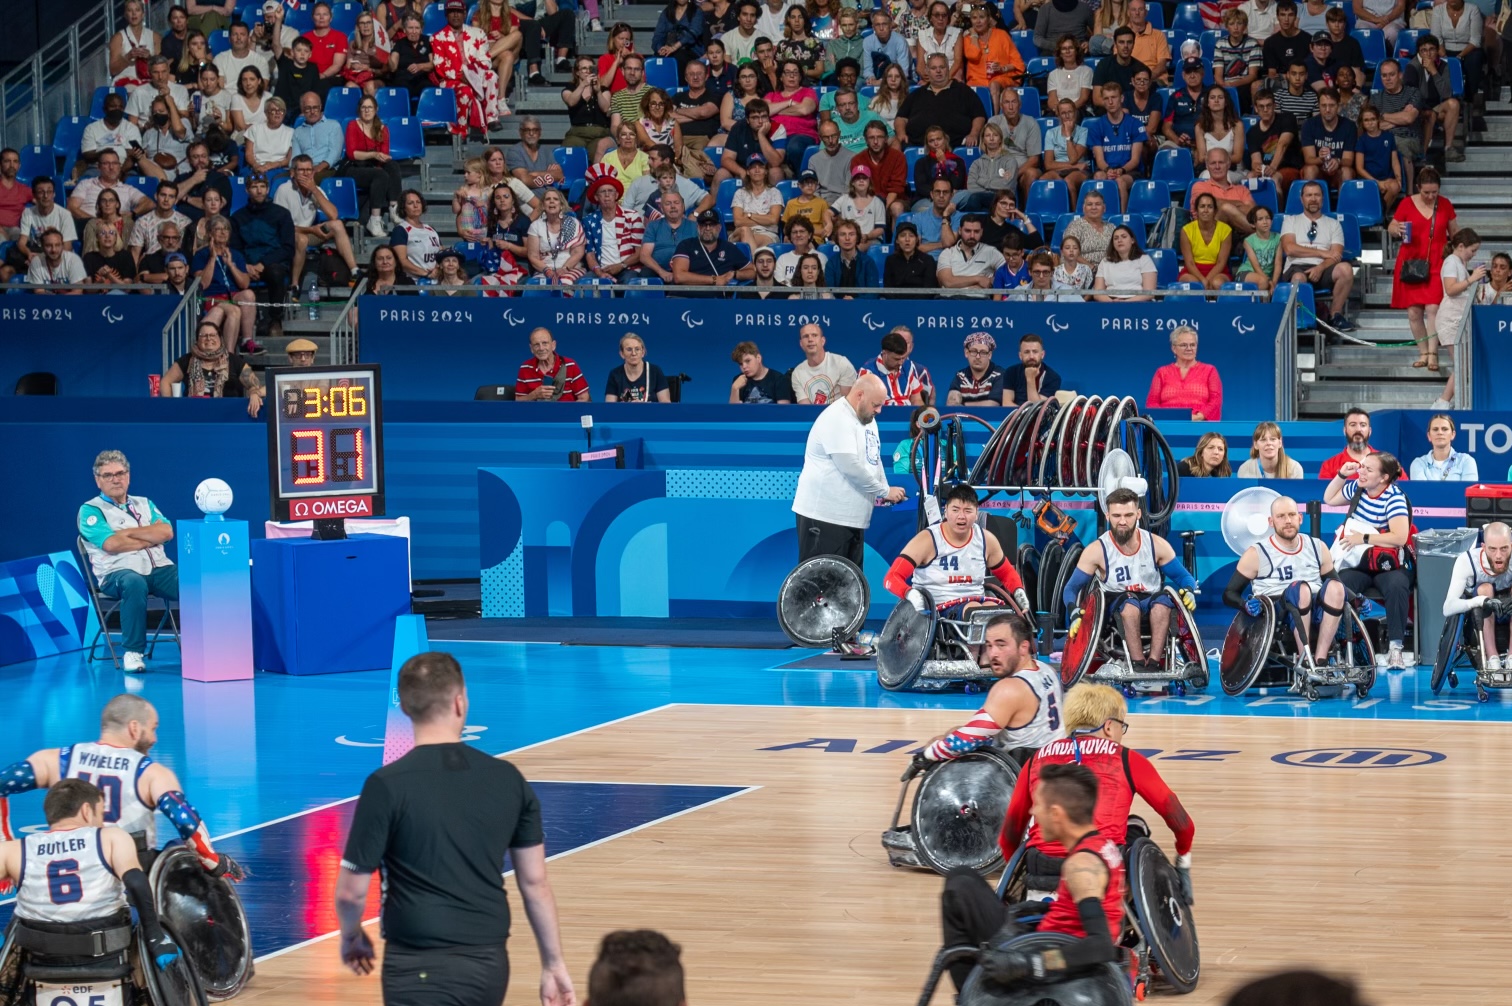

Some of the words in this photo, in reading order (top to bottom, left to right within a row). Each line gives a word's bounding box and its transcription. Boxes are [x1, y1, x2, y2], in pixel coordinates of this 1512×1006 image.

[3, 308, 26, 320] RIS
[304, 386, 367, 418] 3:06
[292, 430, 364, 485] 31
[312, 499, 369, 515] OMEGA
[939, 555, 959, 571] 44
[948, 575, 973, 584] USA
[1114, 565, 1131, 583] 21
[1277, 565, 1293, 581] 15
[1047, 692, 1061, 731] 5
[37, 838, 87, 856] BUTLER
[47, 858, 84, 906] 6
